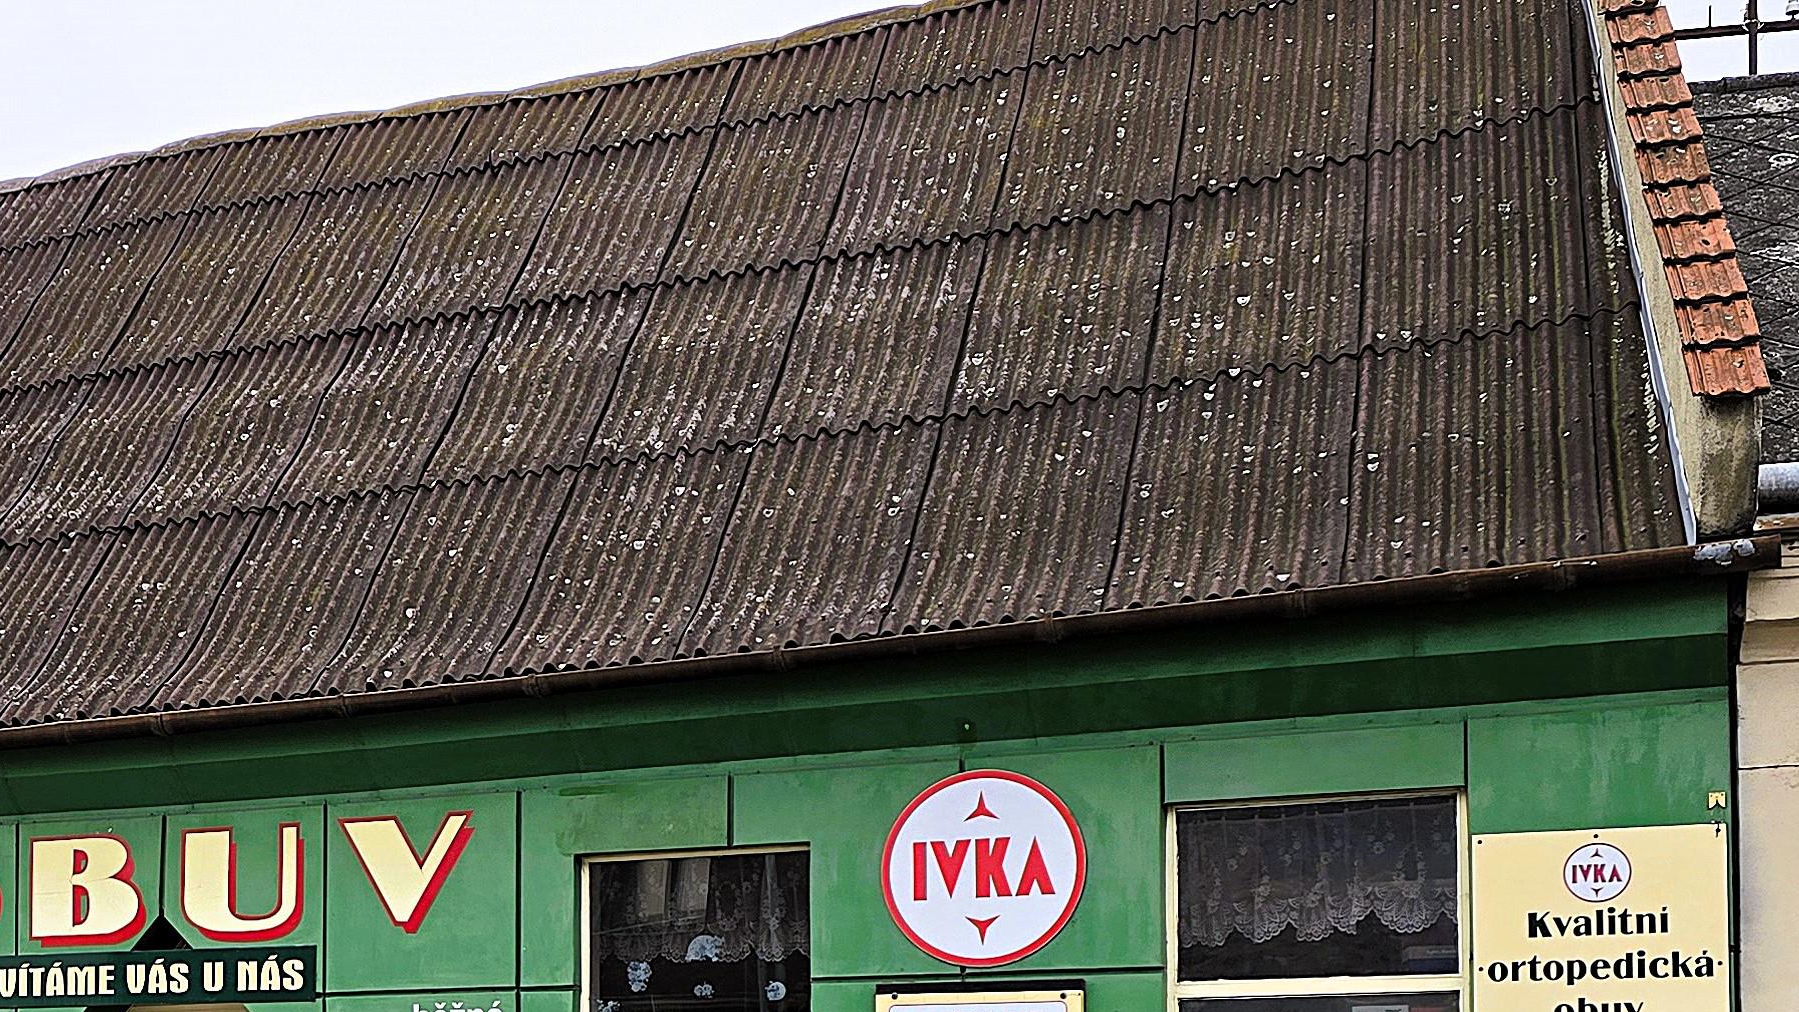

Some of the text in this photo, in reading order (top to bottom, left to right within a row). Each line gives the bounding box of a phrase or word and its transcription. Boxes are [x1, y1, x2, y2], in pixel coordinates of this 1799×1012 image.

[912, 836, 1056, 901] IVKA
[1571, 863, 1623, 884] IVKA
[1527, 907, 1669, 938] Kvalitní
[126, 958, 189, 994] VÁS
[203, 961, 224, 992] U
[237, 954, 304, 992] NÁS
[1487, 950, 1714, 986] ortopedická
